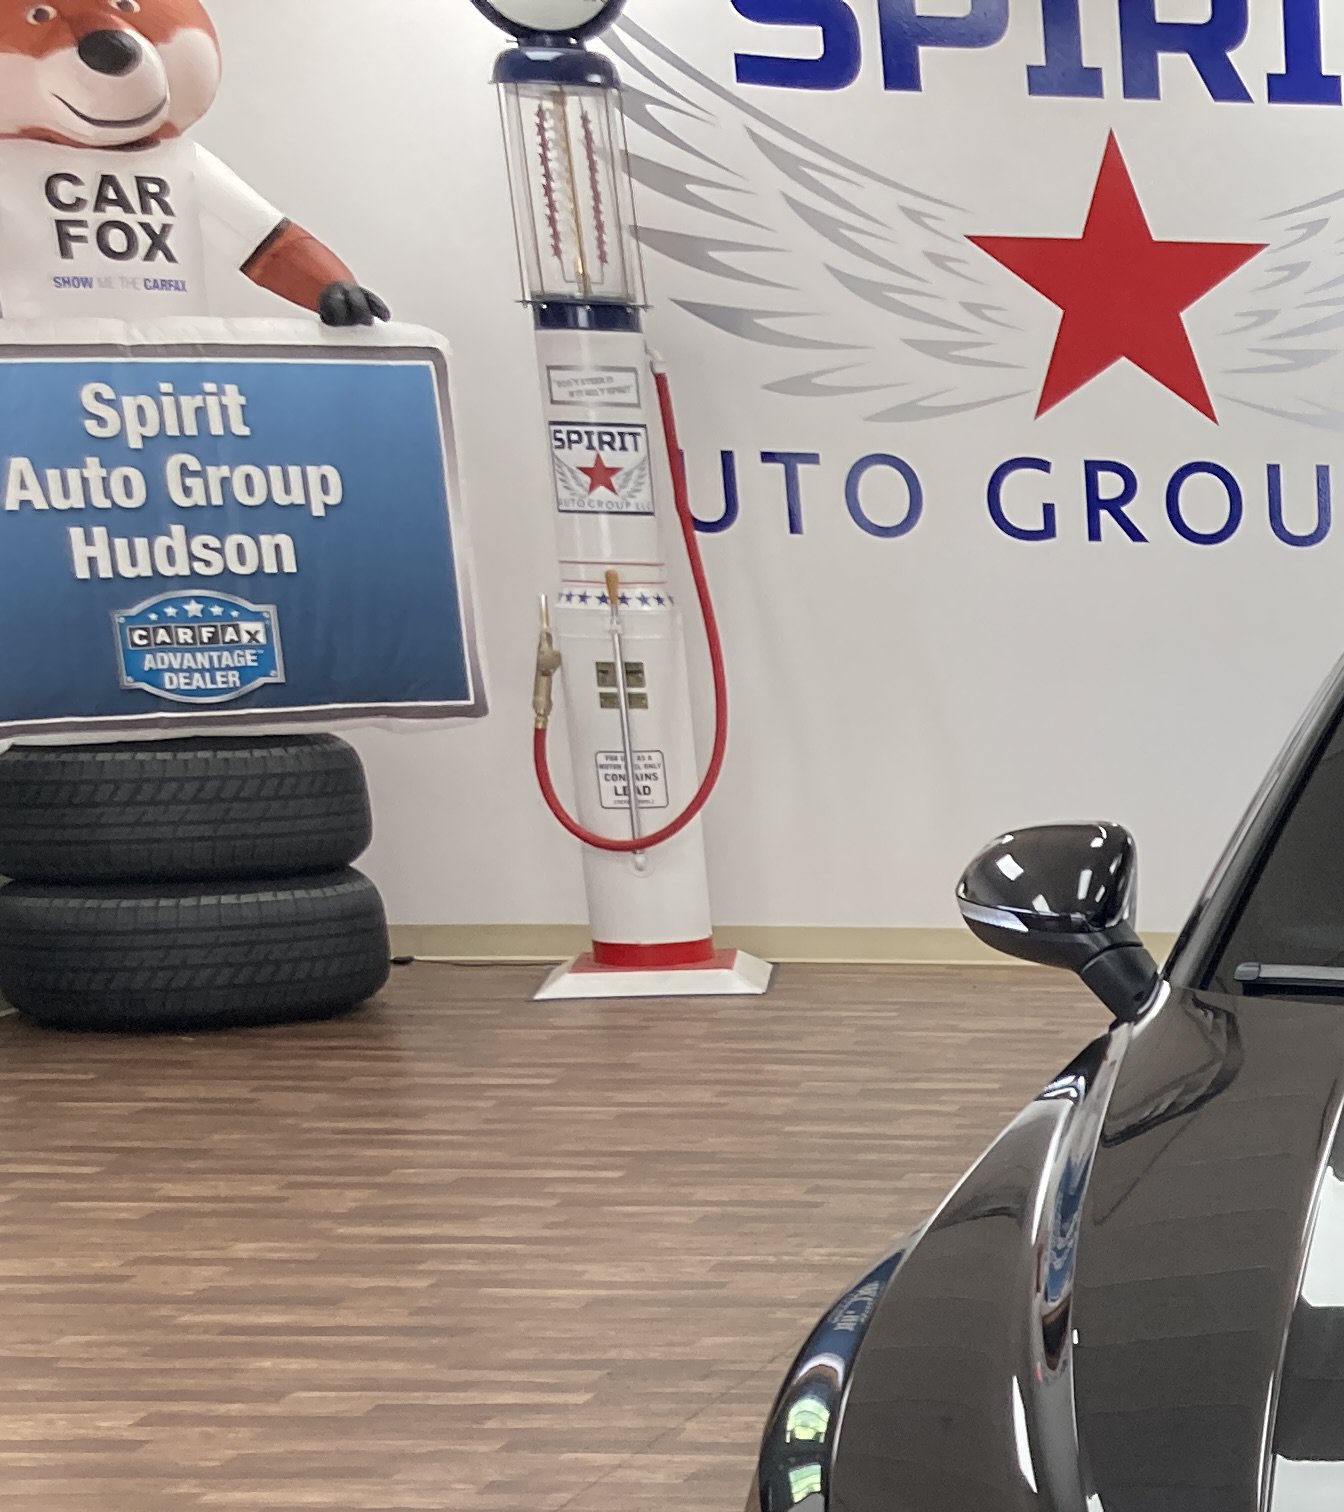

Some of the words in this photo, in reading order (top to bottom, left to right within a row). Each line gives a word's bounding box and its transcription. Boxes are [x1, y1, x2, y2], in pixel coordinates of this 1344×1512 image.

[44, 172, 177, 218] CAR
[54, 219, 179, 265] FOX
[53, 276, 94, 289] SHOW
[143, 277, 188, 293] CARFAX
[80, 381, 251, 450] Spirit
[552, 428, 642, 452] SPIRIT
[4, 456, 148, 511] Auto
[165, 452, 344, 517] Group
[676, 448, 924, 538] UTO
[69, 523, 298, 580] Hudson
[131, 625, 262, 646] CARFAX
[163, 671, 241, 690] DEALER
[604, 773, 659, 782] CONAINS
